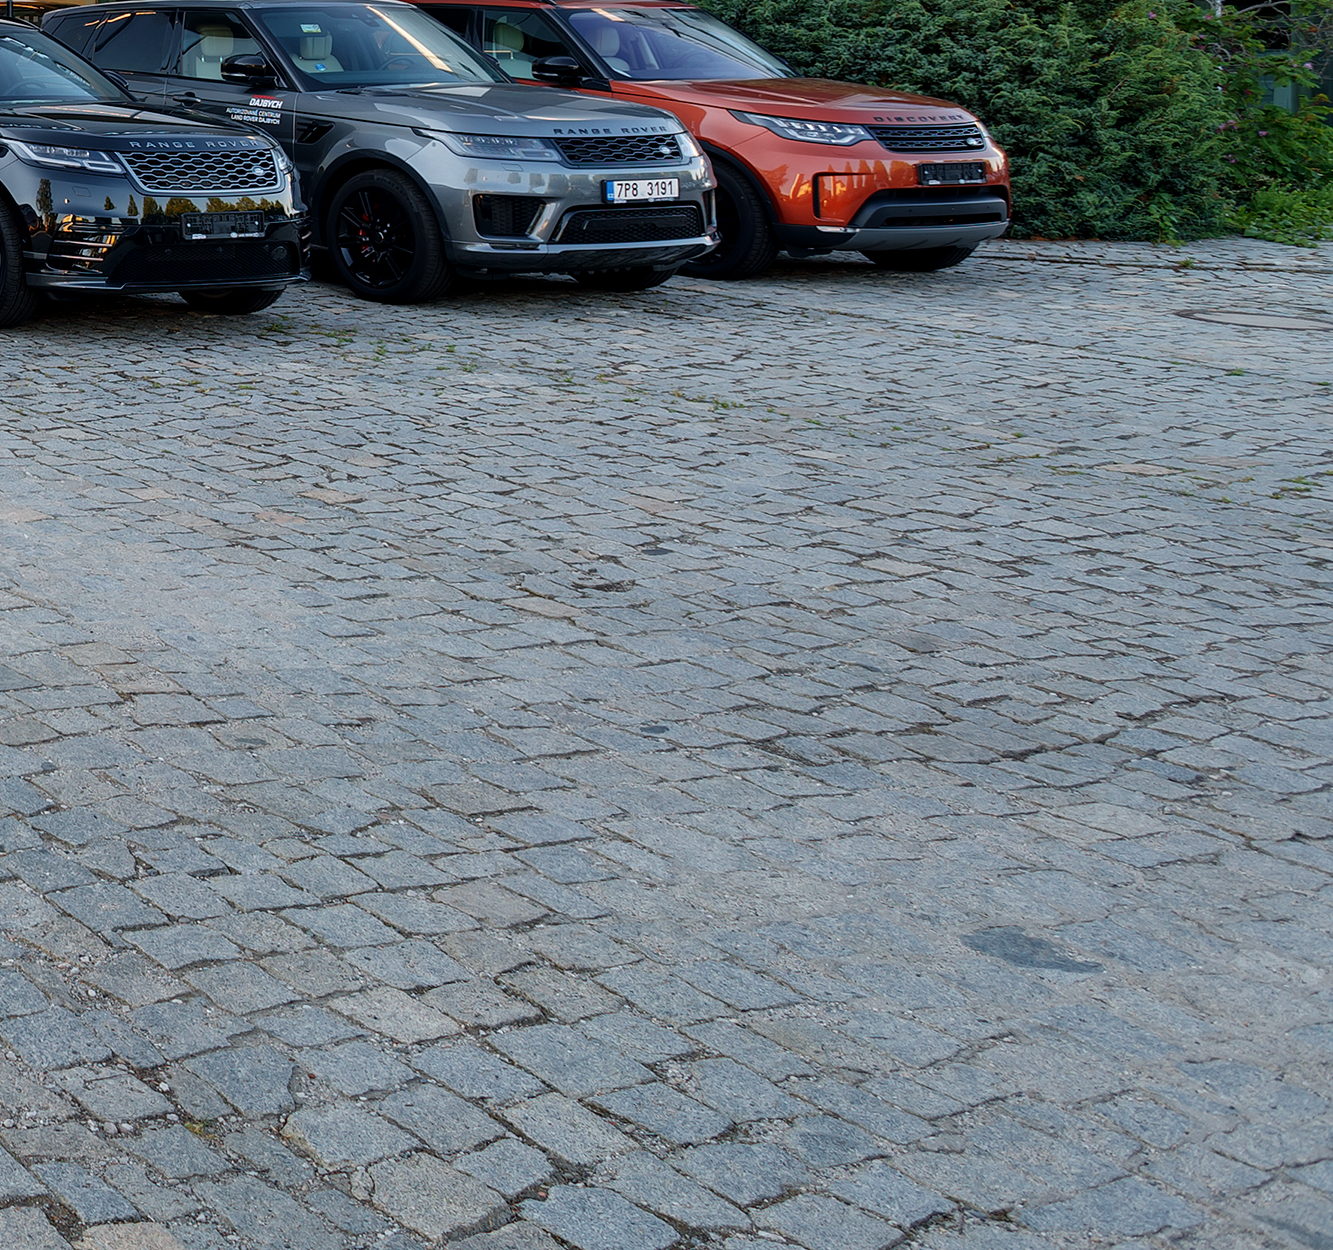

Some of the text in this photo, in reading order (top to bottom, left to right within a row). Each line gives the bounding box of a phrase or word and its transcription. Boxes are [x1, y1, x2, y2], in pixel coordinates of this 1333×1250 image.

[249, 98, 283, 109] DAJBYCH
[873, 114, 965, 123] DISCOVERY
[620, 126, 667, 134] ROVER
[205, 140, 259, 148] ROVER
[616, 181, 673, 198] 7P8 3191
